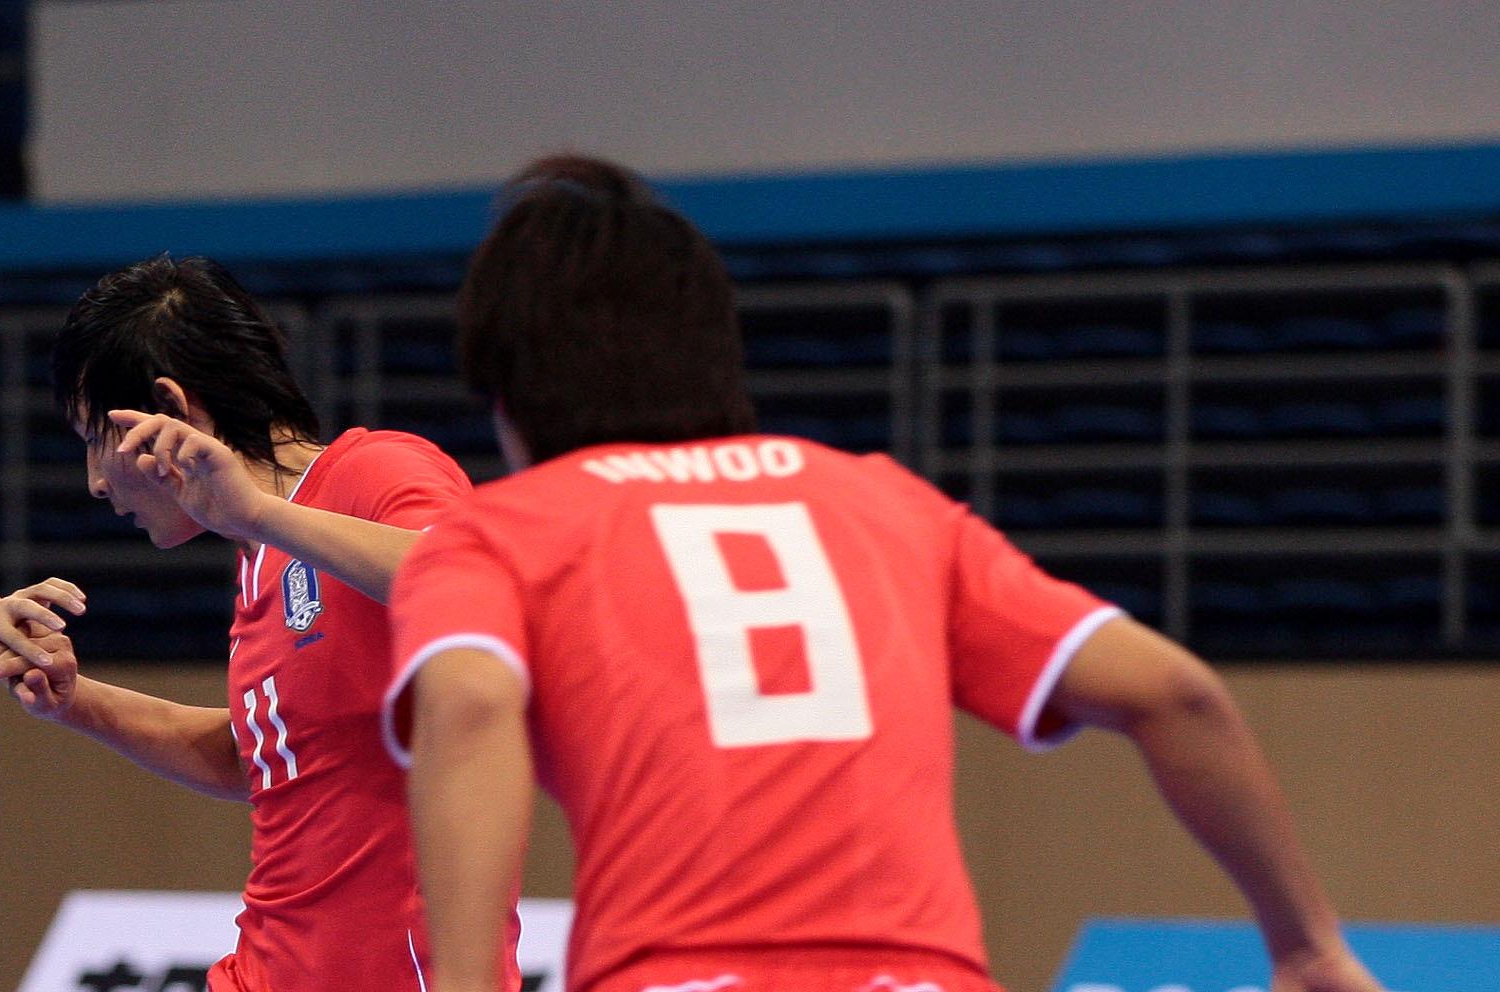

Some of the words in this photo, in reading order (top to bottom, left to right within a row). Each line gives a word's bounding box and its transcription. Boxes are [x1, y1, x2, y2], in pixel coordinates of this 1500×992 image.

[581, 440, 804, 483] INWOO
[649, 501, 874, 748] 8
[243, 676, 298, 790] 11
